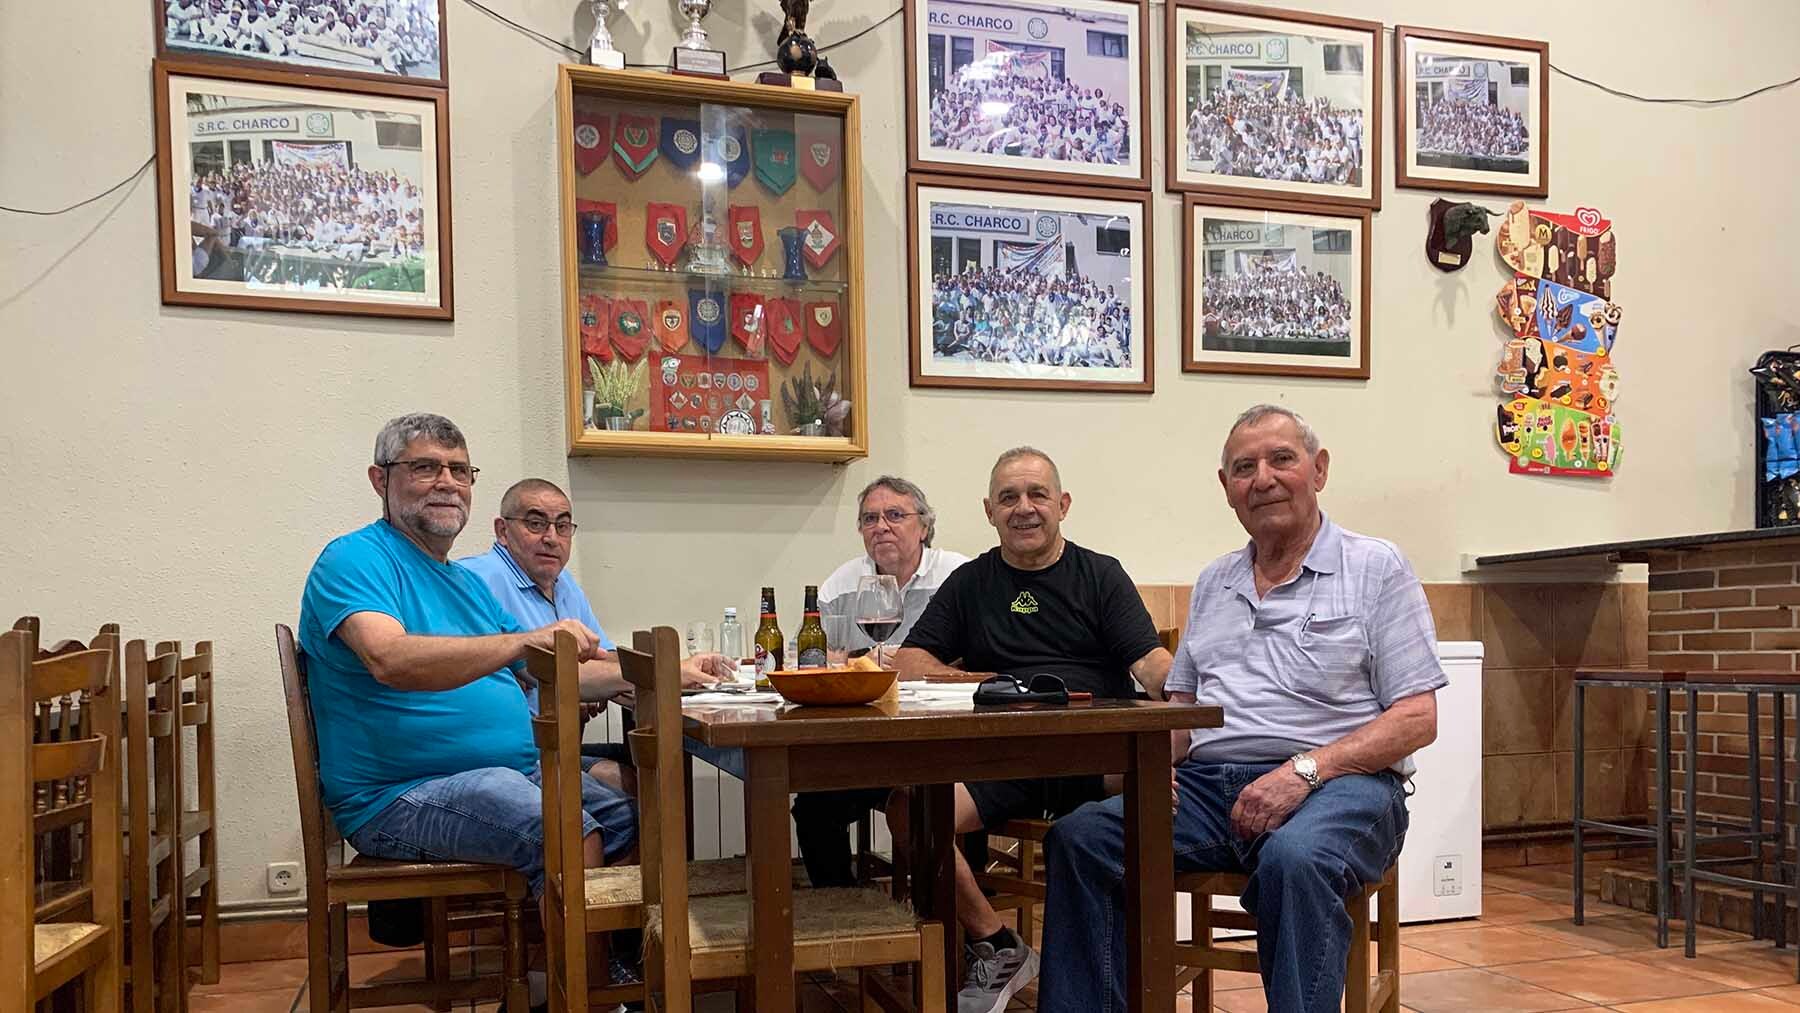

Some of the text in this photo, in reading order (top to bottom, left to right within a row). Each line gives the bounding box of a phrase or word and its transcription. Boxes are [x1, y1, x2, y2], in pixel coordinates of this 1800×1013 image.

[957, 14, 1013, 31] CHARCO
[1209, 43, 1254, 55] CHARCO
[233, 117, 290, 130] CHARCO
[965, 215, 1022, 230] CHARCO
[1212, 230, 1254, 241] CHARCO
